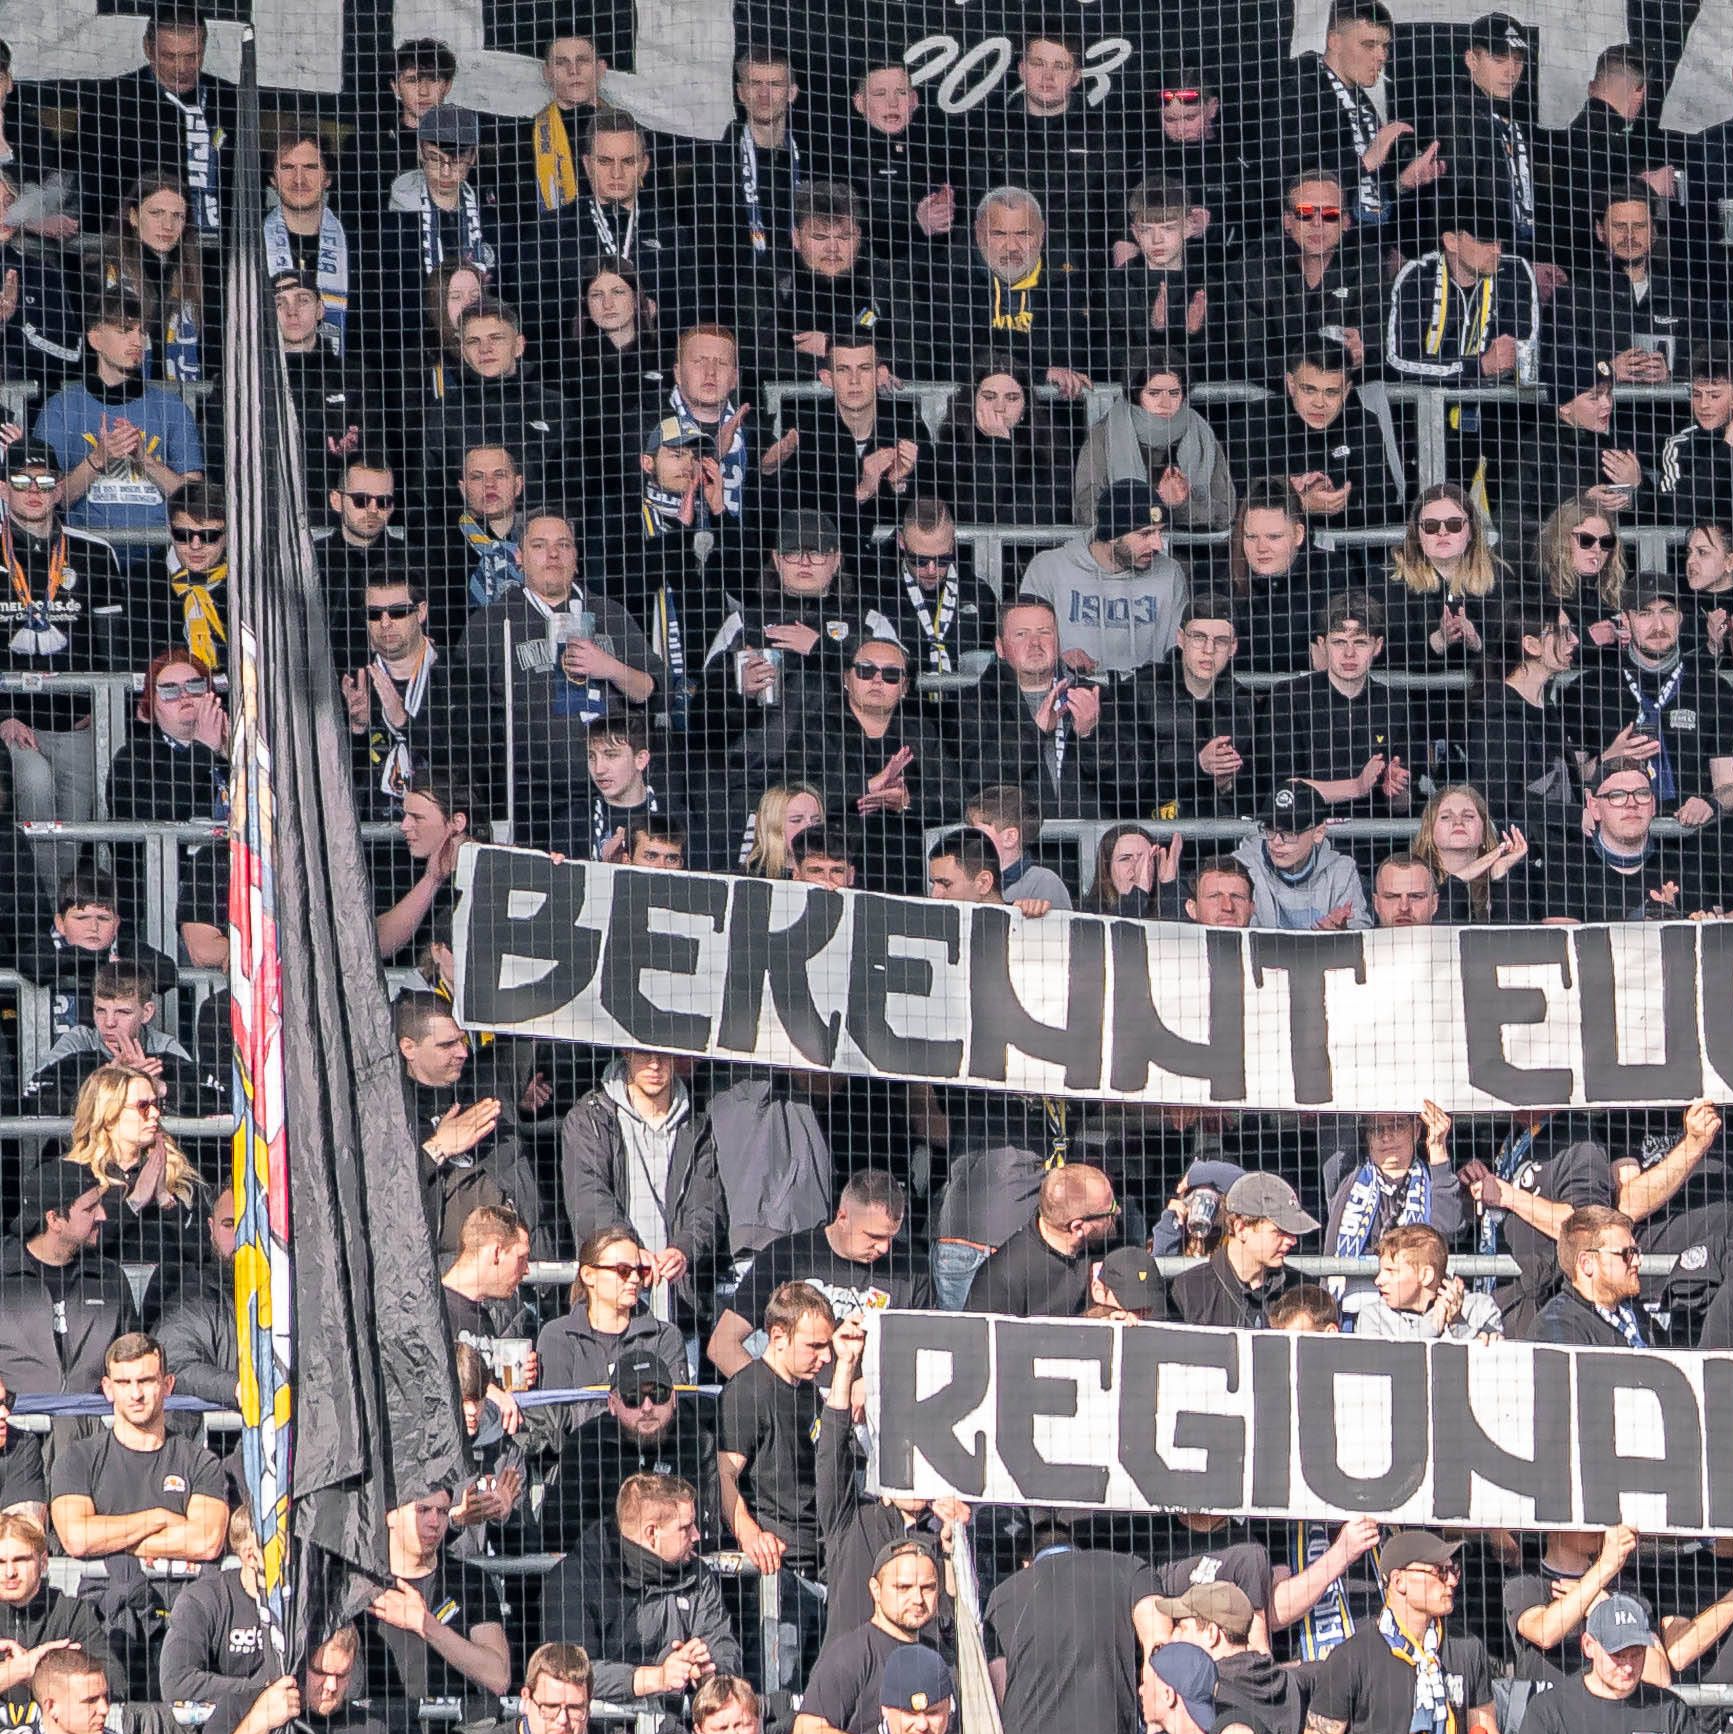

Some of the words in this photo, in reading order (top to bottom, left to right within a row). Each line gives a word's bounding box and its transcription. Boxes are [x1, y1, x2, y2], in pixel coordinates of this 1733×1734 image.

[904, 35, 1132, 113] 203
[1069, 589, 1158, 627] 1903
[462, 847, 1368, 1104] BEKENNT
